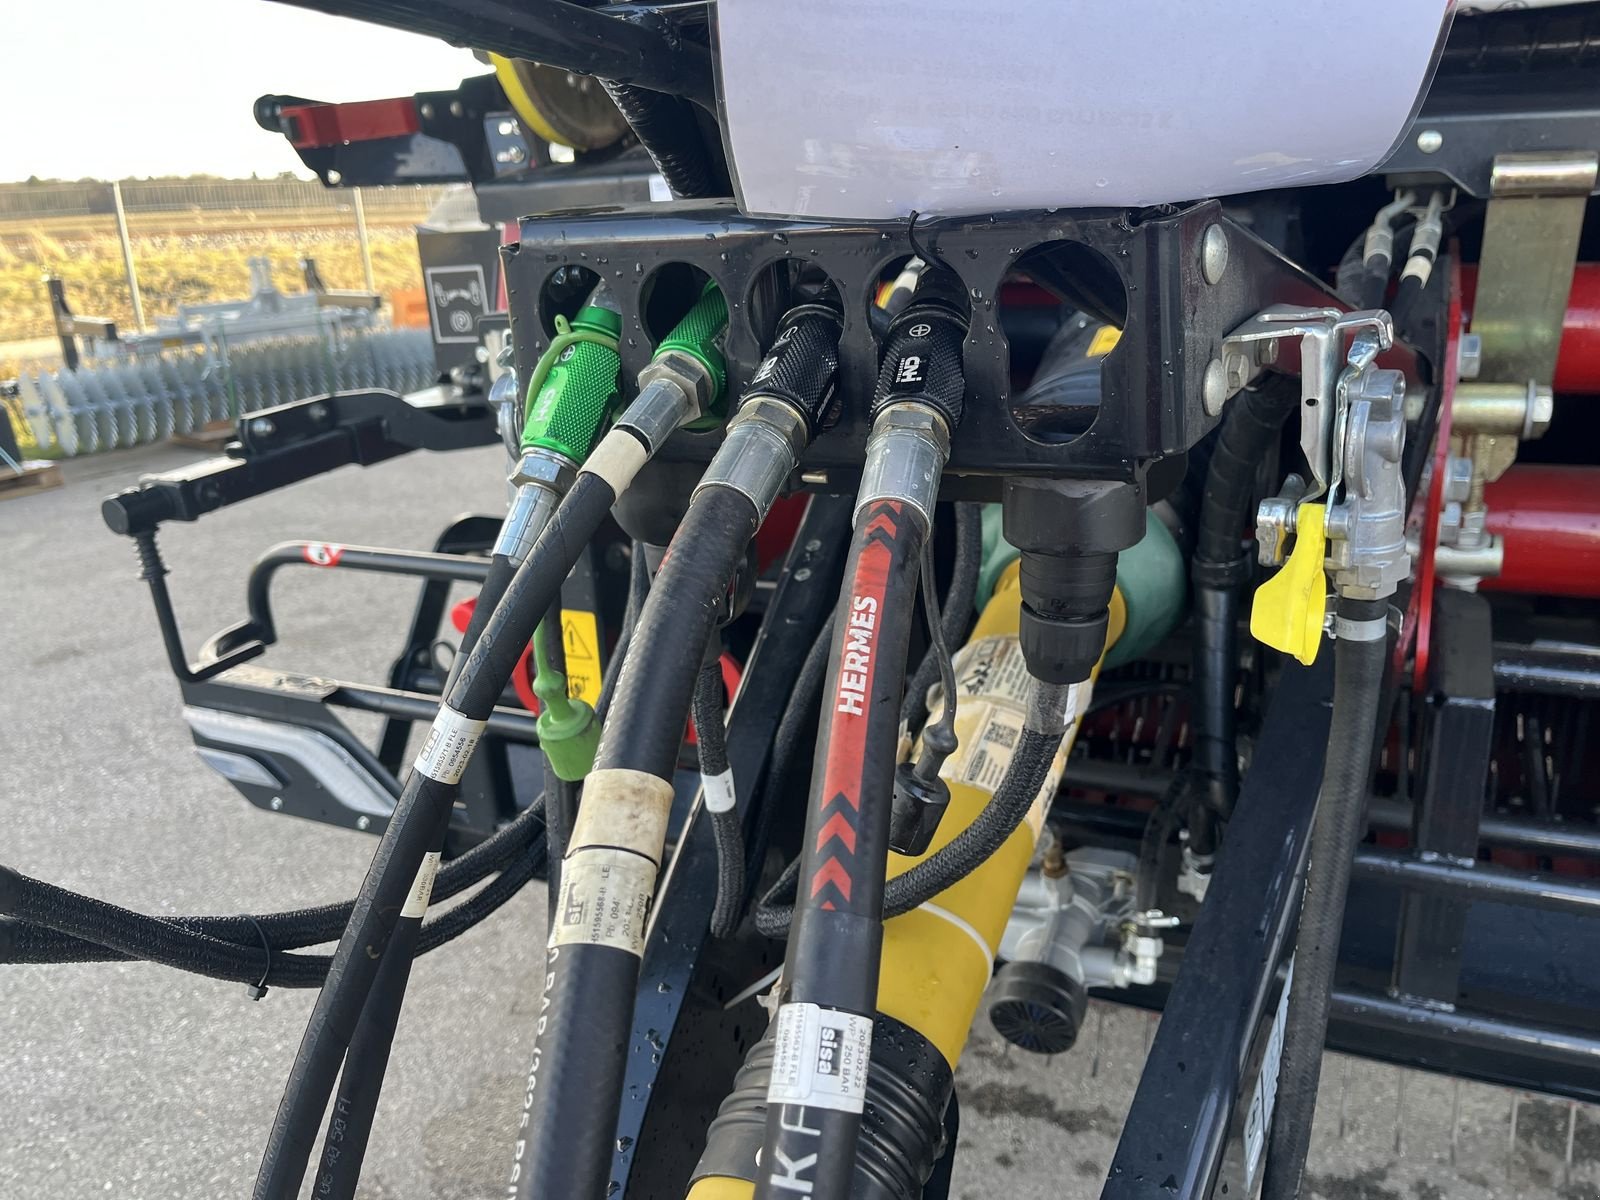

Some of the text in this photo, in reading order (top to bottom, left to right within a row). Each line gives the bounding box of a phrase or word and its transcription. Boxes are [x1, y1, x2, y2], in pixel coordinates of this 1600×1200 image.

[837, 595, 877, 716] HERMES
[421, 729, 439, 759] sisa
[601, 865, 610, 880] LE
[817, 1027, 837, 1074] sisa
[843, 1044, 851, 1065] 250
[854, 1029, 865, 1088] 2023-02-22
[840, 1068, 849, 1093] BAR
